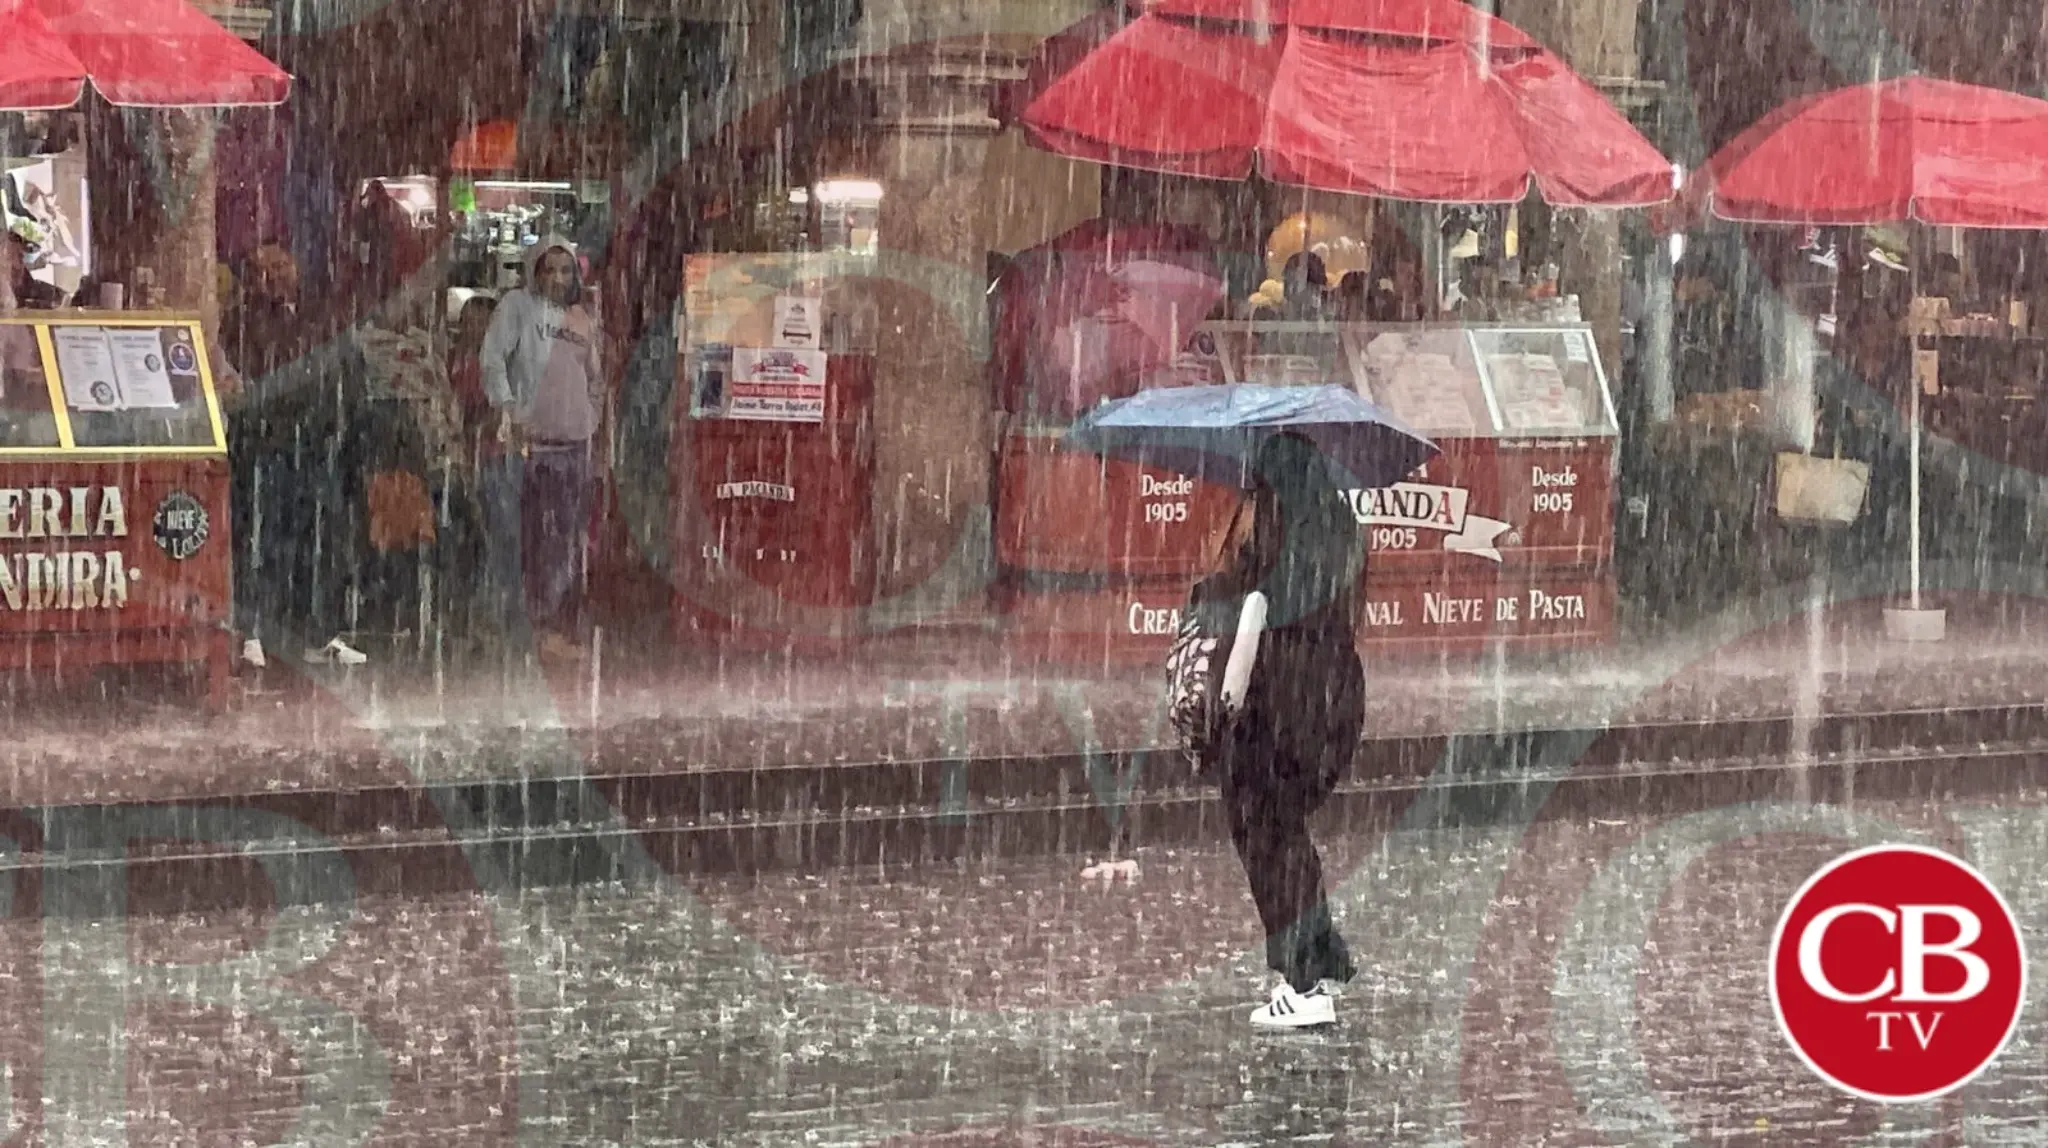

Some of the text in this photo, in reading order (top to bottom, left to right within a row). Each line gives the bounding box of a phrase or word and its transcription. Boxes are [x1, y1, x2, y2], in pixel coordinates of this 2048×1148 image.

[1142, 474, 1194, 496] Desde
[1532, 465, 1578, 487] Desde
[1145, 503, 1187, 523] 1905
[1533, 493, 1573, 512] 1905
[1371, 528, 1417, 550] 1905
[1423, 592, 1483, 624] NIEVE
[1529, 590, 1585, 620] PASTA
